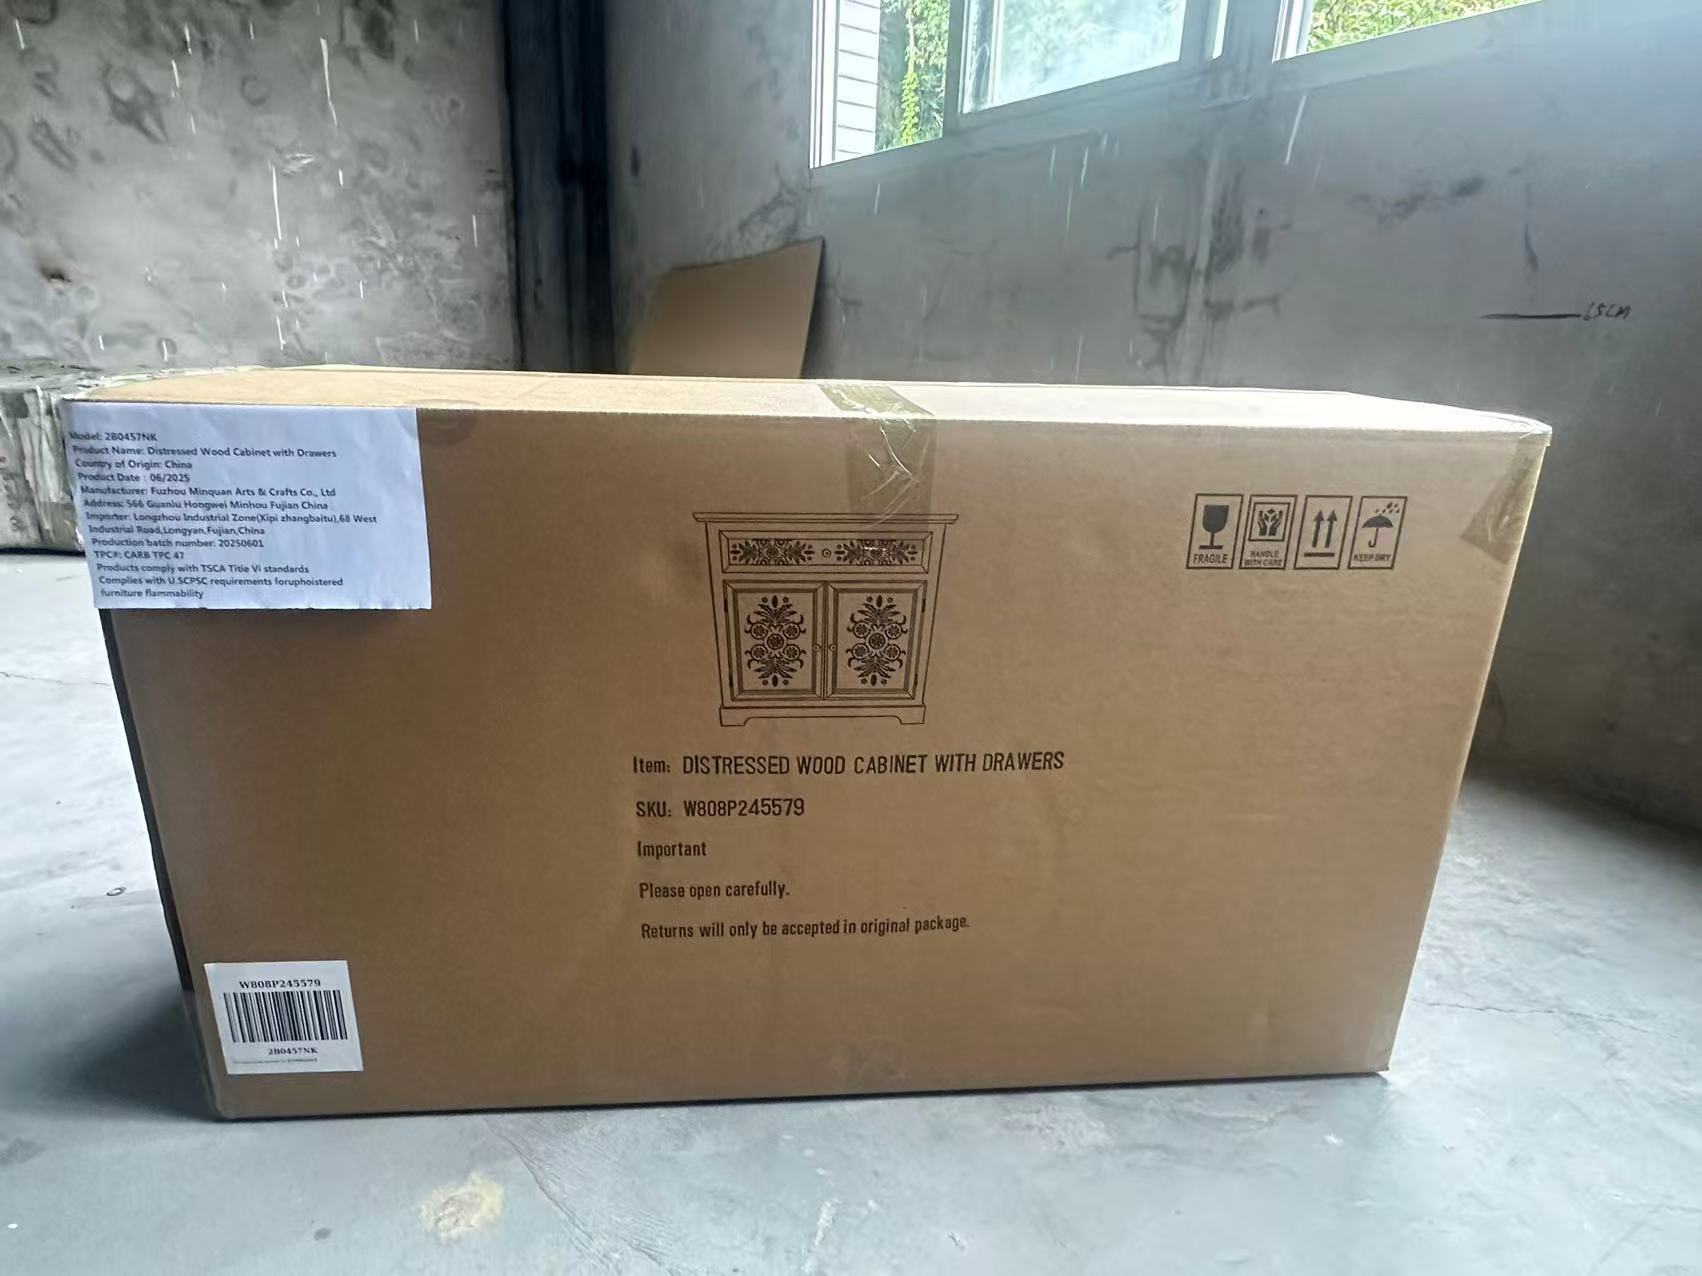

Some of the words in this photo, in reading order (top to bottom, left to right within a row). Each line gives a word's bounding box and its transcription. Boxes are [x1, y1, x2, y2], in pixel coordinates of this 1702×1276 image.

[69, 432, 101, 441] Model:
[105, 432, 157, 441] 2B0457NK
[73, 445, 109, 455] Product
[112, 446, 143, 455] Name:
[147, 447, 197, 456] Distressed
[200, 448, 230, 457] Wood
[233, 448, 271, 457] Cabinet
[273, 448, 294, 457] with
[297, 449, 336, 458] Drawers
[75, 459, 112, 469] Country
[115, 460, 125, 468] of
[128, 460, 162, 470] Origin:
[165, 460, 192, 469] China
[78, 473, 114, 482] Product
[117, 473, 140, 482] Date
[150, 474, 190, 483] 06/2025
[80, 486, 147, 495] Manufacturer:
[151, 487, 186, 496] Fuzhou
[190, 487, 232, 499] Minquan
[236, 488, 255, 496] Arts
[258, 488, 266, 496] &
[269, 488, 298, 496] Crafts
[321, 488, 336, 496] Ltd
[84, 500, 124, 508] Address:
[184, 500, 228, 511] Hongwei
[230, 501, 268, 510] Minhou
[271, 501, 299, 511] Fujian
[301, 501, 328, 510] China
[86, 512, 130, 522] Importer:
[134, 512, 181, 523] Longzhou
[184, 512, 229, 522] Industrial
[232, 513, 278, 524] Zone(Xipi
[353, 515, 377, 523] West
[88, 525, 134, 534] Industrial
[92, 538, 144, 547] Production
[147, 538, 172, 547] batch
[175, 539, 215, 547] number:
[218, 539, 264, 548] 20250601
[124, 551, 150, 559] CARB
[153, 551, 171, 559] TPC
[1193, 553, 1228, 564] FRAGILE
[1250, 550, 1279, 558] HANDLE
[1354, 553, 1374, 562] KEEP
[1375, 553, 1391, 562] DRY
[1263, 558, 1283, 566] CARE
[97, 563, 139, 572] Products
[141, 564, 175, 574] comply
[178, 564, 198, 572] with
[200, 564, 225, 572] TSCA
[264, 565, 309, 573] standards
[99, 576, 143, 586] Complies
[145, 576, 166, 585] with
[210, 577, 272, 588] requirements
[101, 589, 142, 597] furniture
[145, 589, 204, 599] flammability
[633, 756, 671, 773] Item:
[683, 755, 790, 775] DISTRESSED
[797, 756, 845, 774] WOOD
[854, 754, 928, 774] CABINET
[935, 753, 976, 772] WITH
[983, 751, 1065, 771] DRAWERS
[636, 801, 672, 817] SKU:
[683, 798, 805, 817] W808P245579
[637, 841, 706, 860] Important
[639, 882, 685, 898] Please
[690, 885, 720, 900] open
[726, 881, 790, 899] carefully.
[641, 923, 693, 938] Returns
[699, 922, 724, 937] will
[729, 921, 757, 939] only
[762, 921, 777, 935] be
[782, 920, 840, 937] accepted
[843, 919, 856, 934] in
[861, 918, 910, 936] original
[915, 915, 970, 934] package.
[239, 979, 321, 989] W808P245579
[268, 1047, 318, 1056] 2B0457NK
